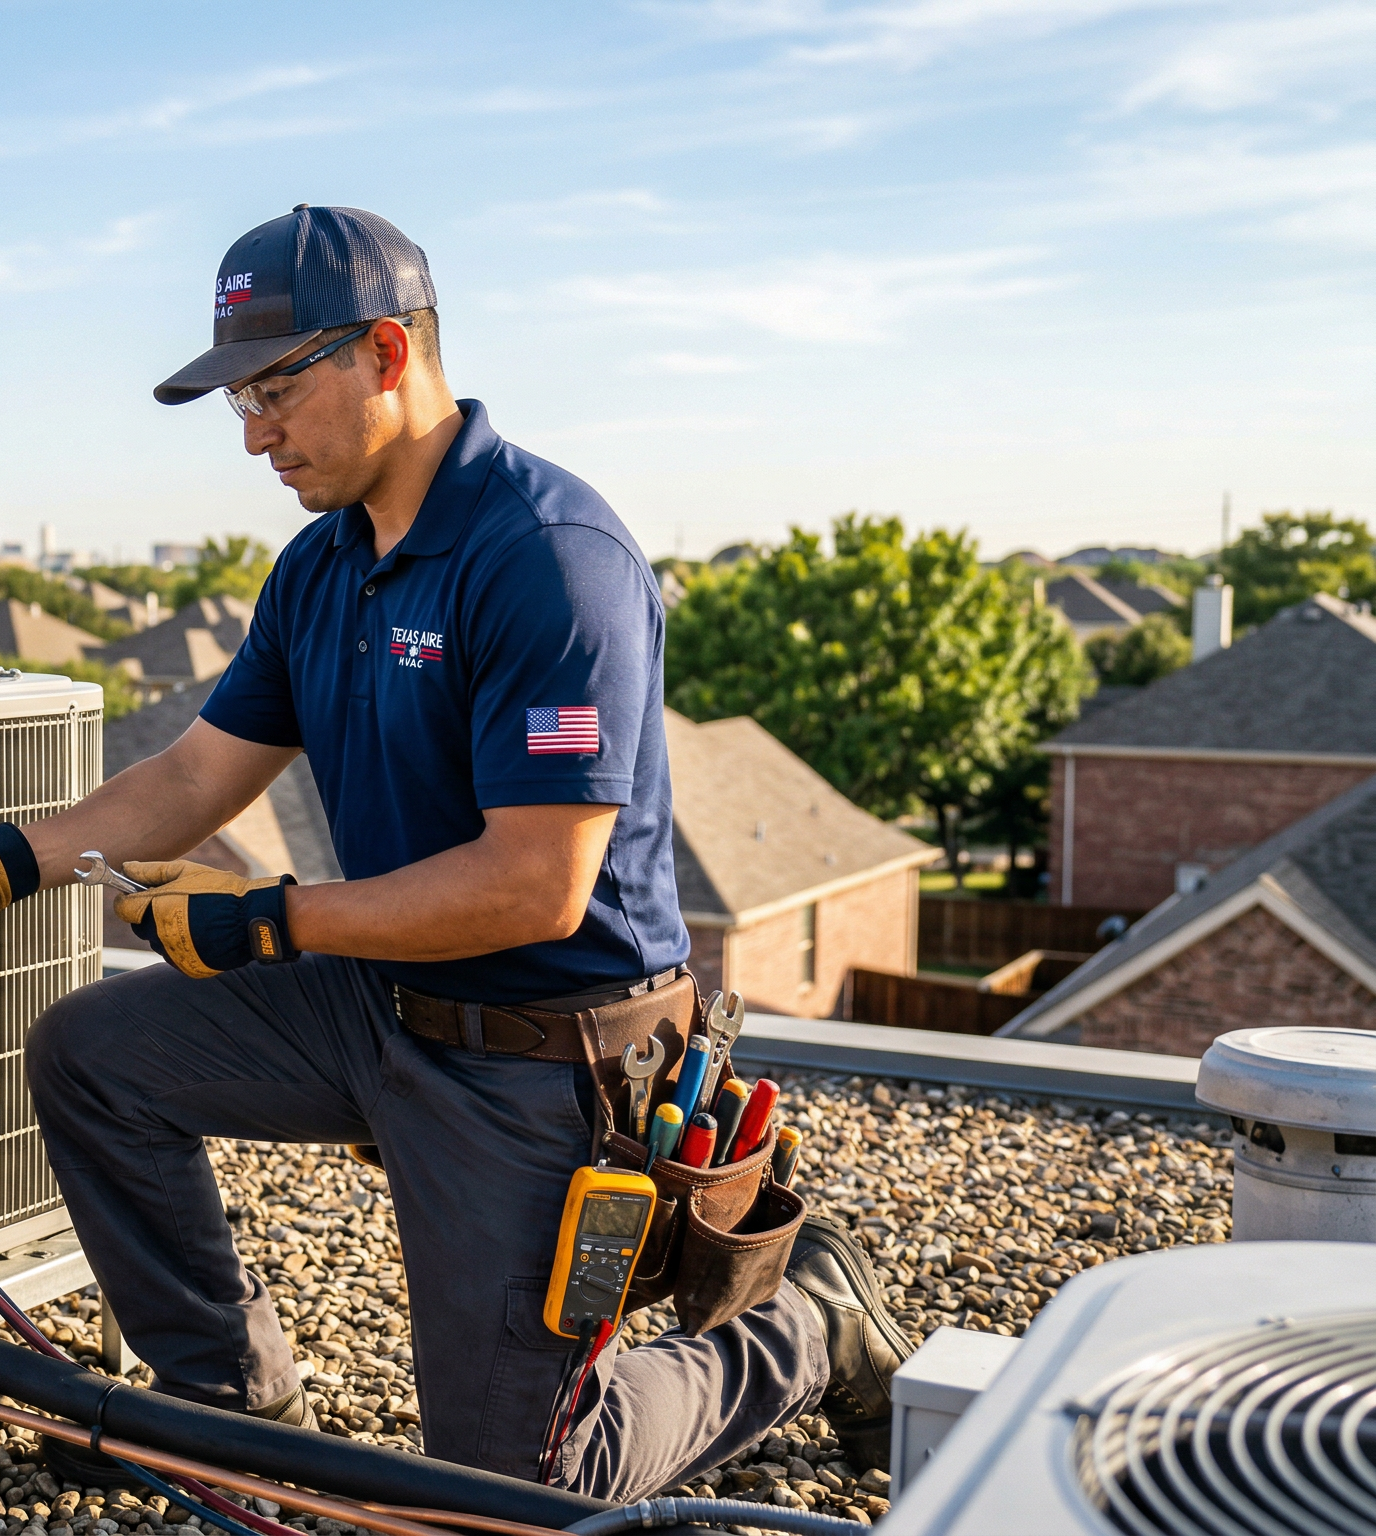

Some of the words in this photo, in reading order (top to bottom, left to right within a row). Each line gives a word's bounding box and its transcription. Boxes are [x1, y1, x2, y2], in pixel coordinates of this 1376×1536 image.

[224, 272, 253, 292] AIRE
[391, 627, 420, 645] TEXAS
[419, 631, 443, 649] AIRE
